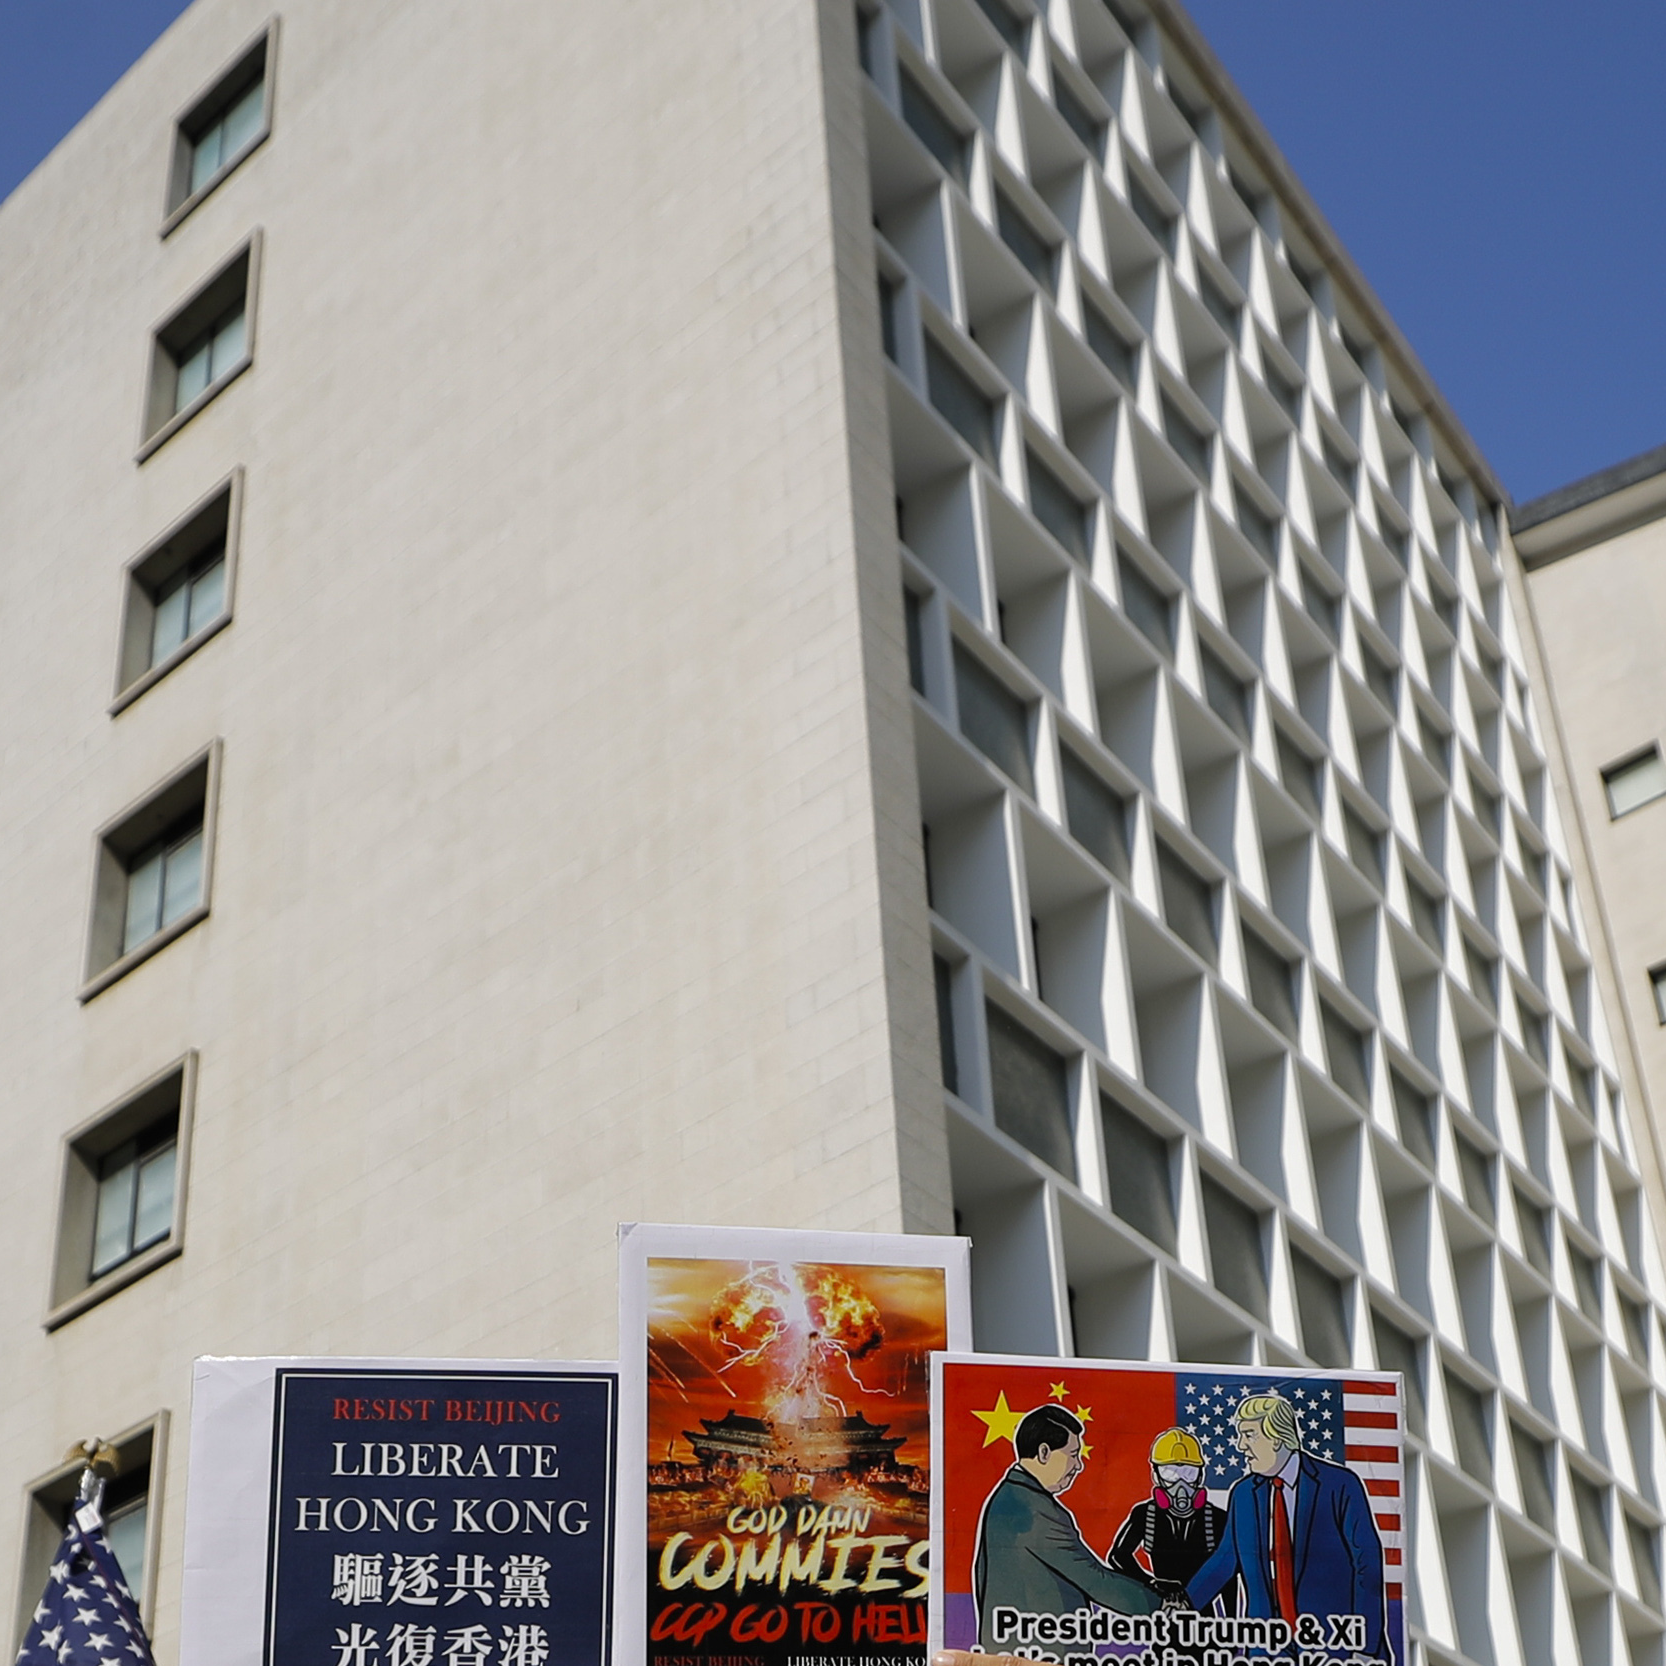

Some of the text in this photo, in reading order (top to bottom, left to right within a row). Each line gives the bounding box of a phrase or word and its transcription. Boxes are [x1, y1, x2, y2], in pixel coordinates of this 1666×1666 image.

[333, 1397, 562, 1426] RESIST BEIJING
[331, 1441, 560, 1479] LIBERATE
[294, 1496, 592, 1536] HONG KONG
[726, 1504, 872, 1538] GOD DAMN
[331, 1552, 552, 1609] 驅逐共黨
[657, 1531, 929, 1599] COMMIES
[649, 1600, 928, 1646] CCP GO TO HELL
[995, 1610, 1366, 1652] President Trump & Xi
